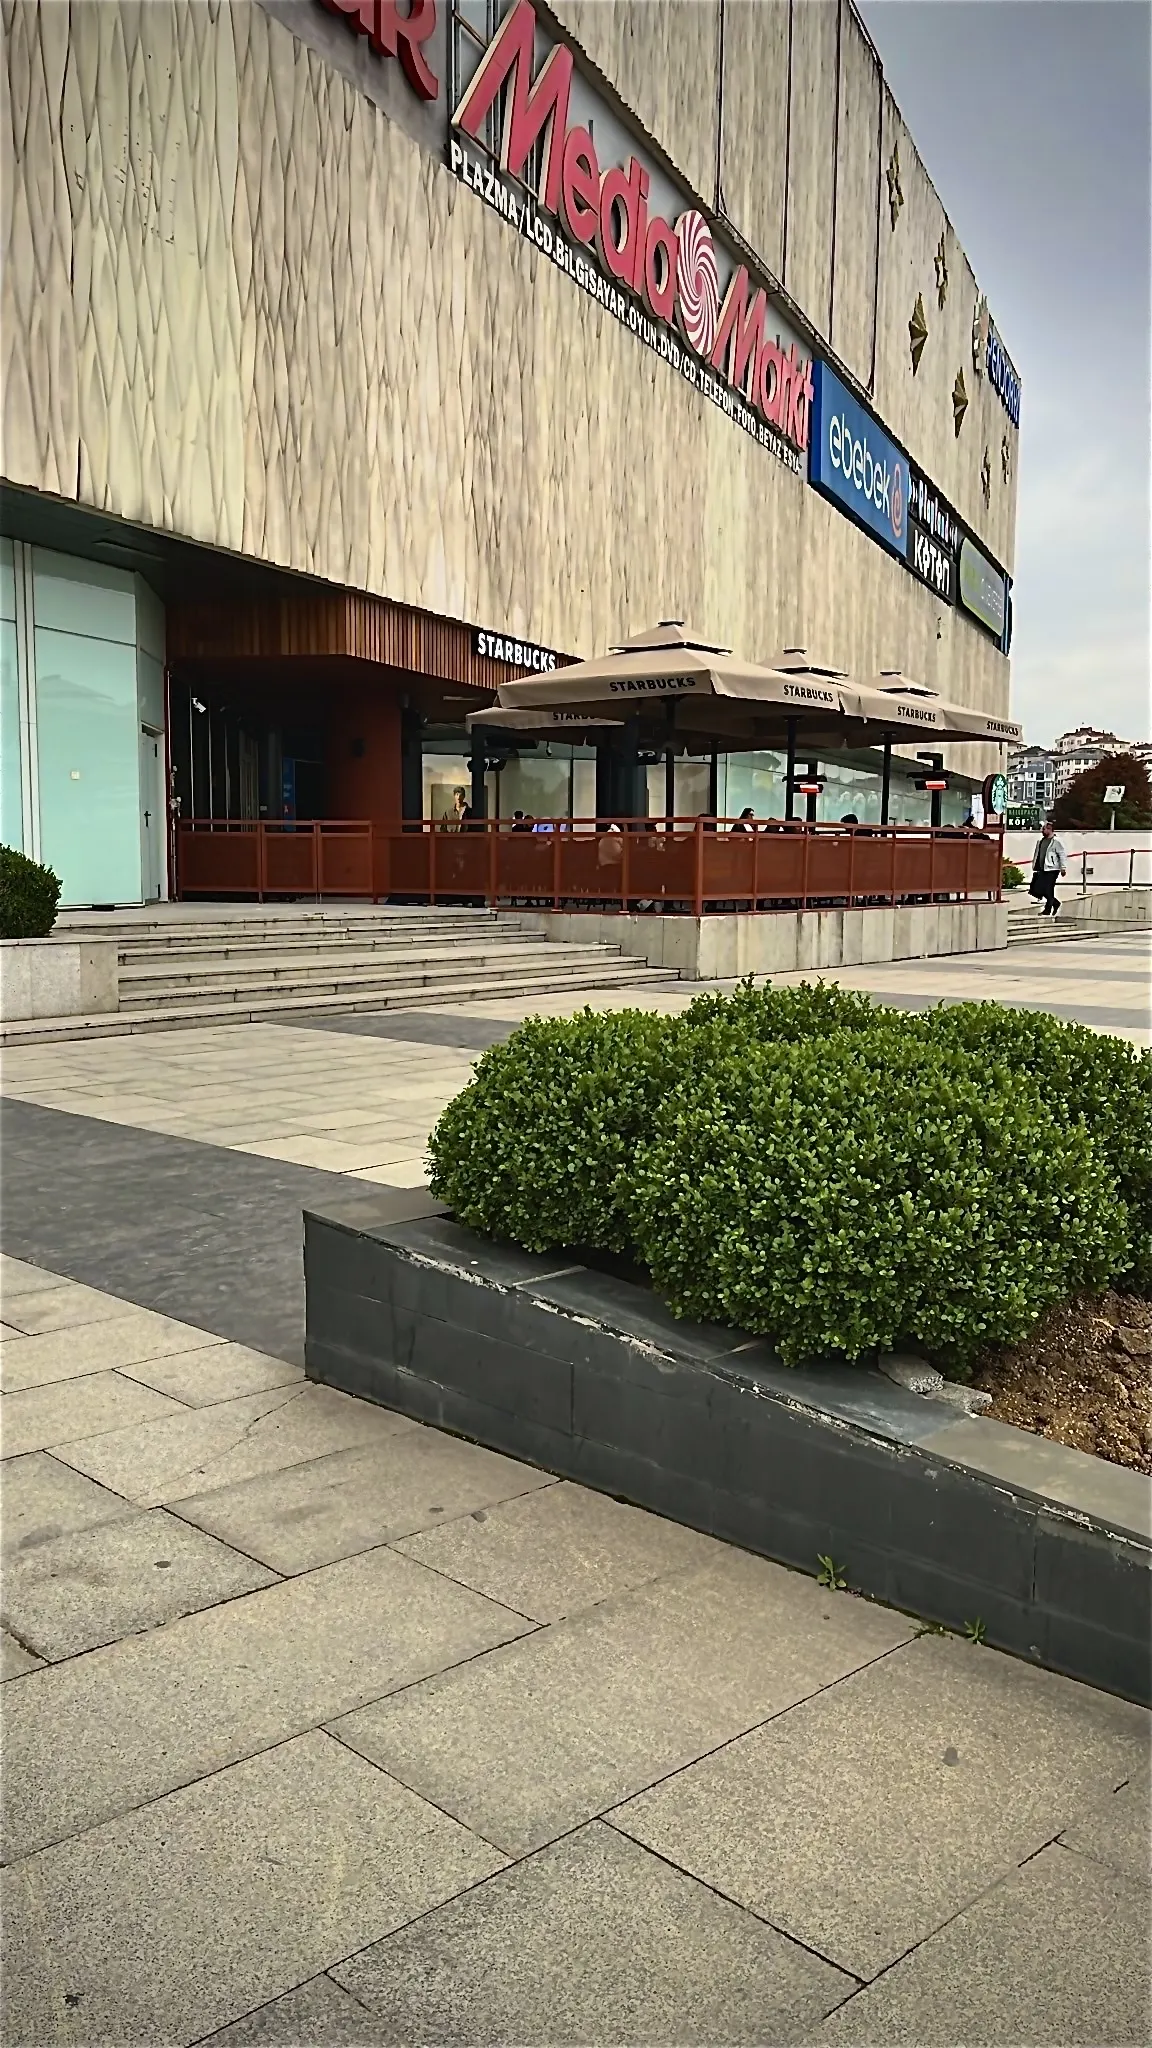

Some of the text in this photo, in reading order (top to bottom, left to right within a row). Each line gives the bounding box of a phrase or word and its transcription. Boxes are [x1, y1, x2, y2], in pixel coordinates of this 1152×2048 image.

[451, 0, 814, 450] Media Markt
[829, 413, 890, 518] ebebek
[477, 632, 556, 672] STARBUCKS
[609, 676, 696, 692] STARBUCKS
[783, 684, 833, 703] STARBUCKS
[897, 706, 936, 723] STARBUCKS
[986, 720, 1019, 737] STARBUCKS
